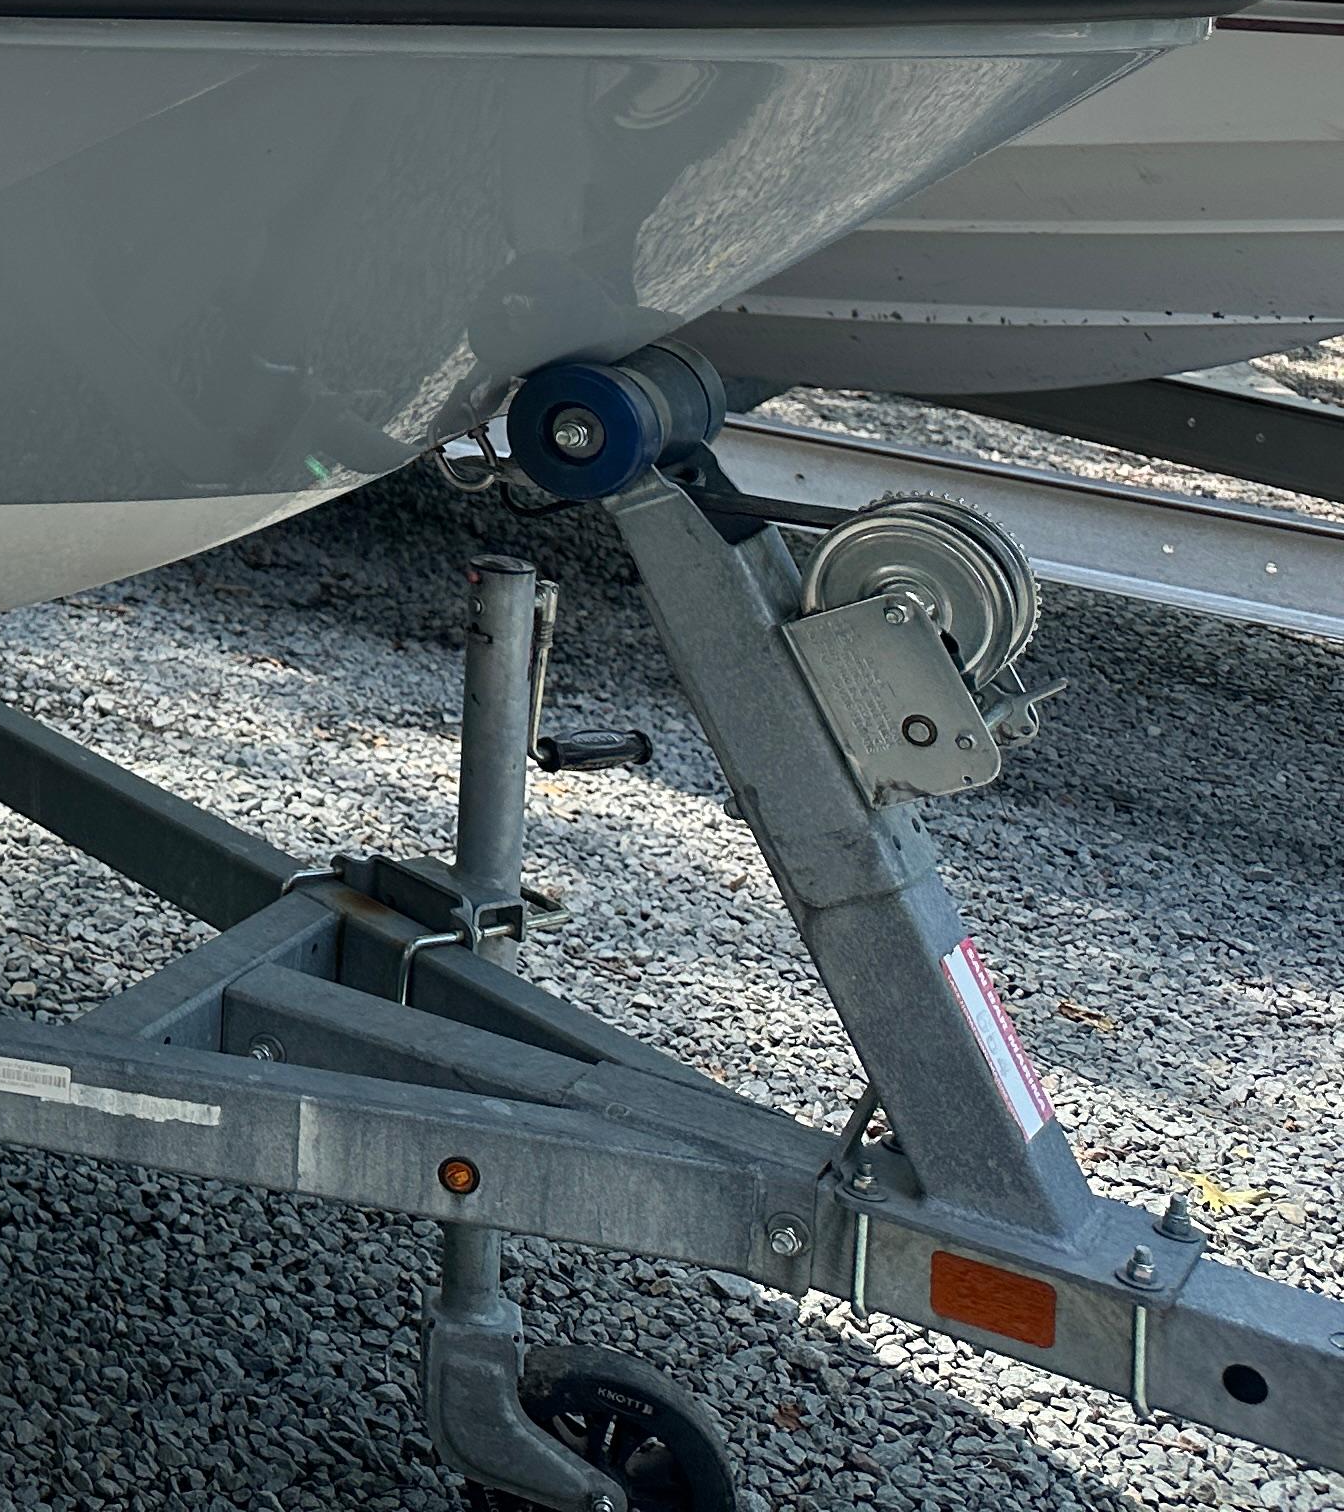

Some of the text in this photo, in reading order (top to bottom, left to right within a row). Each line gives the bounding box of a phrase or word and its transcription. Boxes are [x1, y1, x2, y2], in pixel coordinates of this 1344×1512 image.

[966, 946, 1046, 1112] SAN BAR MARINA
[598, 1386, 642, 1410] KNOTT
